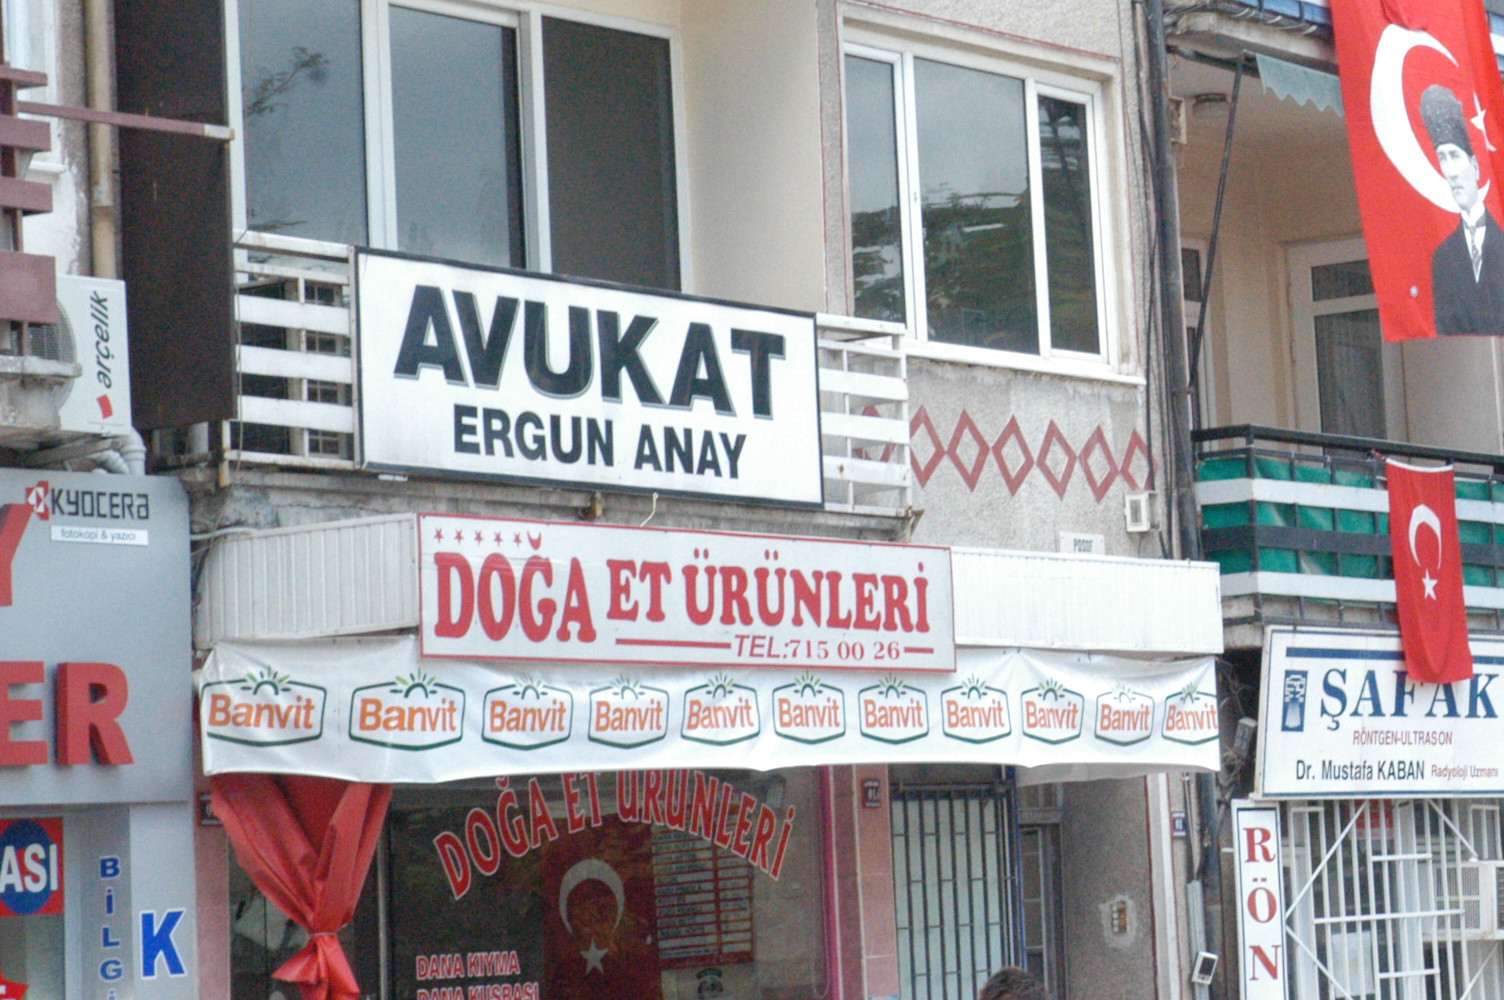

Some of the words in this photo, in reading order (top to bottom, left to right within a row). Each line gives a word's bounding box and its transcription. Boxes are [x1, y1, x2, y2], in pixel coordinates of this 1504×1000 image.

[90, 290, 112, 389] arçelik
[394, 285, 786, 420] AVUKAT
[454, 403, 614, 467] ERGUN
[634, 423, 747, 479] ANAY
[51, 488, 149, 520] KYOCERA
[61, 528, 98, 542] fotokopi
[101, 530, 107, 540] &
[434, 551, 596, 643] DOĞA
[607, 559, 672, 622] ET
[682, 547, 930, 633] ÜRÜNLERİ
[838, 641, 865, 660] 00
[874, 641, 900, 660] 26
[208, 693, 315, 730] Banvit
[359, 698, 457, 732] Banvit
[489, 698, 566, 733] Banvit
[595, 698, 663, 732] Banvit
[688, 699, 755, 730] Banvit
[779, 699, 840, 729] Banvit
[864, 698, 923, 728] Banvit
[947, 698, 1005, 728] Banvit
[1026, 701, 1078, 729] Banvit
[1100, 704, 1150, 731] Banvit
[1166, 702, 1217, 731] Banvit
[1320, 668, 1499, 731] ŞAFAK
[1353, 728, 1453, 745] RÖNTGEN-ULTRASON
[1296, 759, 1315, 781] Dr.
[1321, 760, 1374, 781] Mustafa
[1377, 760, 1424, 781] KABAN
[433, 775, 558, 900] DOĞA
[562, 771, 602, 833] ET
[0, 843, 59, 893] ASI
[416, 953, 465, 980] DANA
[467, 951, 520, 977] KIYMA
